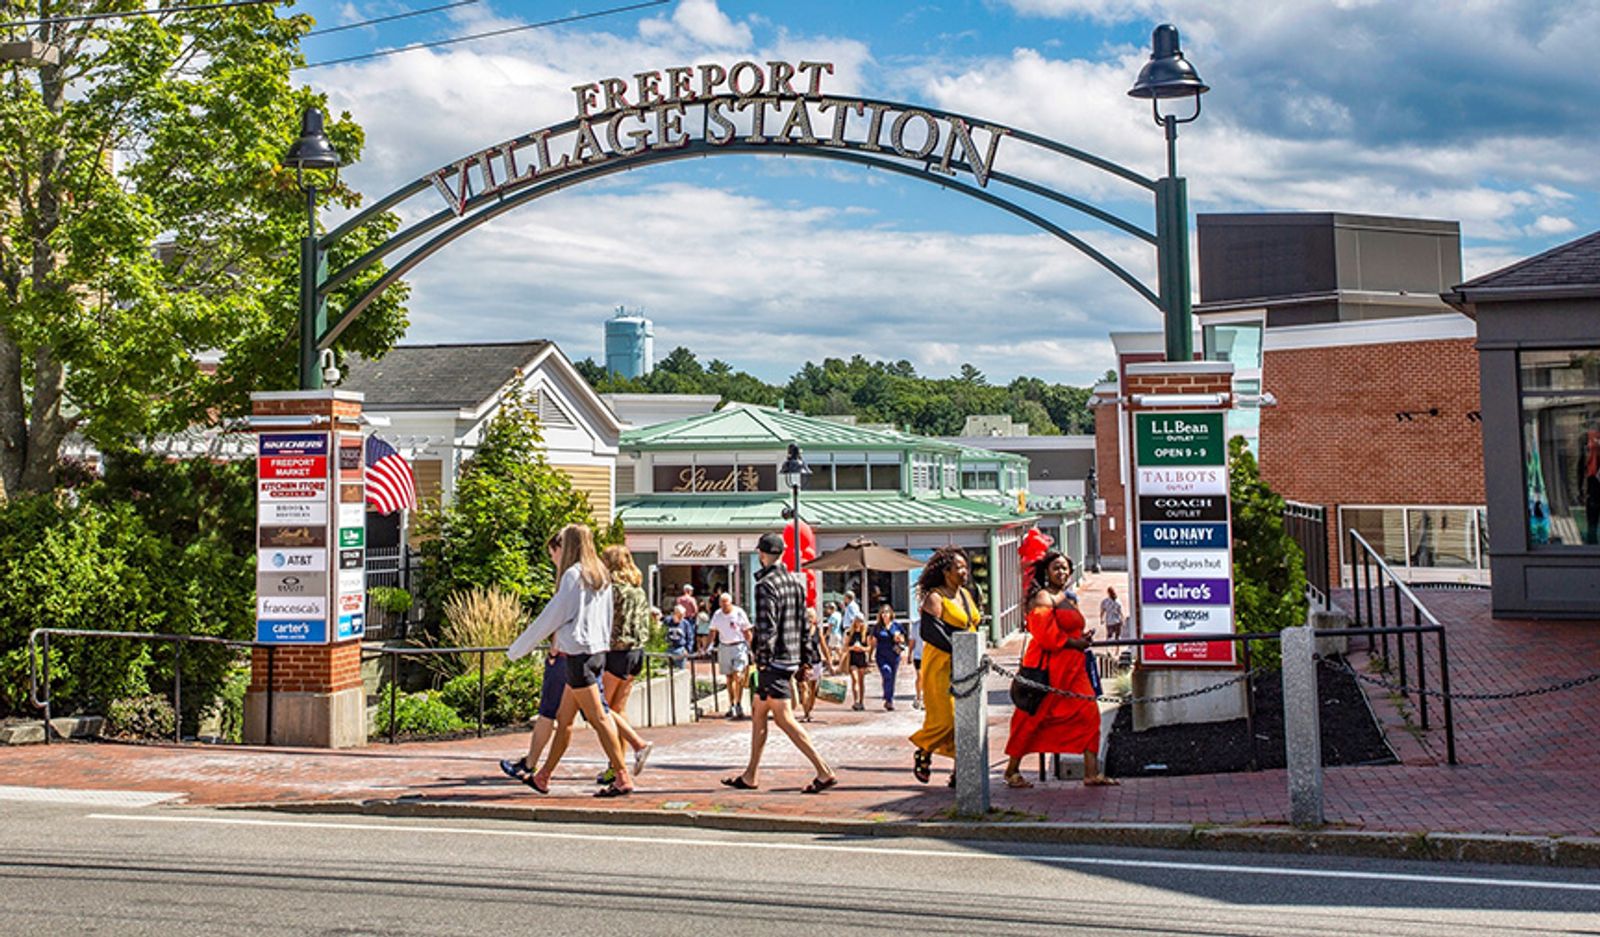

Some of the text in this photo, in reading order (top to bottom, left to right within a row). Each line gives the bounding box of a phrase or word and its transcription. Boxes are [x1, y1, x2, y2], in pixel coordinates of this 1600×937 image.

[571, 60, 833, 120] FREEPORT
[424, 96, 1009, 216] VILLAGE STATION
[263, 440, 324, 449] SKECHERS
[1154, 448, 1183, 457] OPEN
[1185, 448, 1192, 457] 9
[1200, 448, 1207, 457] 9
[270, 459, 315, 467] FREEPORT
[275, 468, 310, 476] MARKET
[1143, 470, 1217, 483] TALBOTS
[672, 467, 742, 492] Lindt
[261, 482, 326, 491] KITCHEN STORE
[1154, 498, 1213, 508] COACH
[1153, 527, 1213, 540] OLD NAVY
[671, 541, 715, 558] Lindt
[287, 555, 312, 566] AT&T
[1162, 558, 1221, 570] sunglass hut
[1155, 583, 1211, 600] claire's
[263, 600, 320, 614] francesca's
[272, 623, 309, 634] carter's
